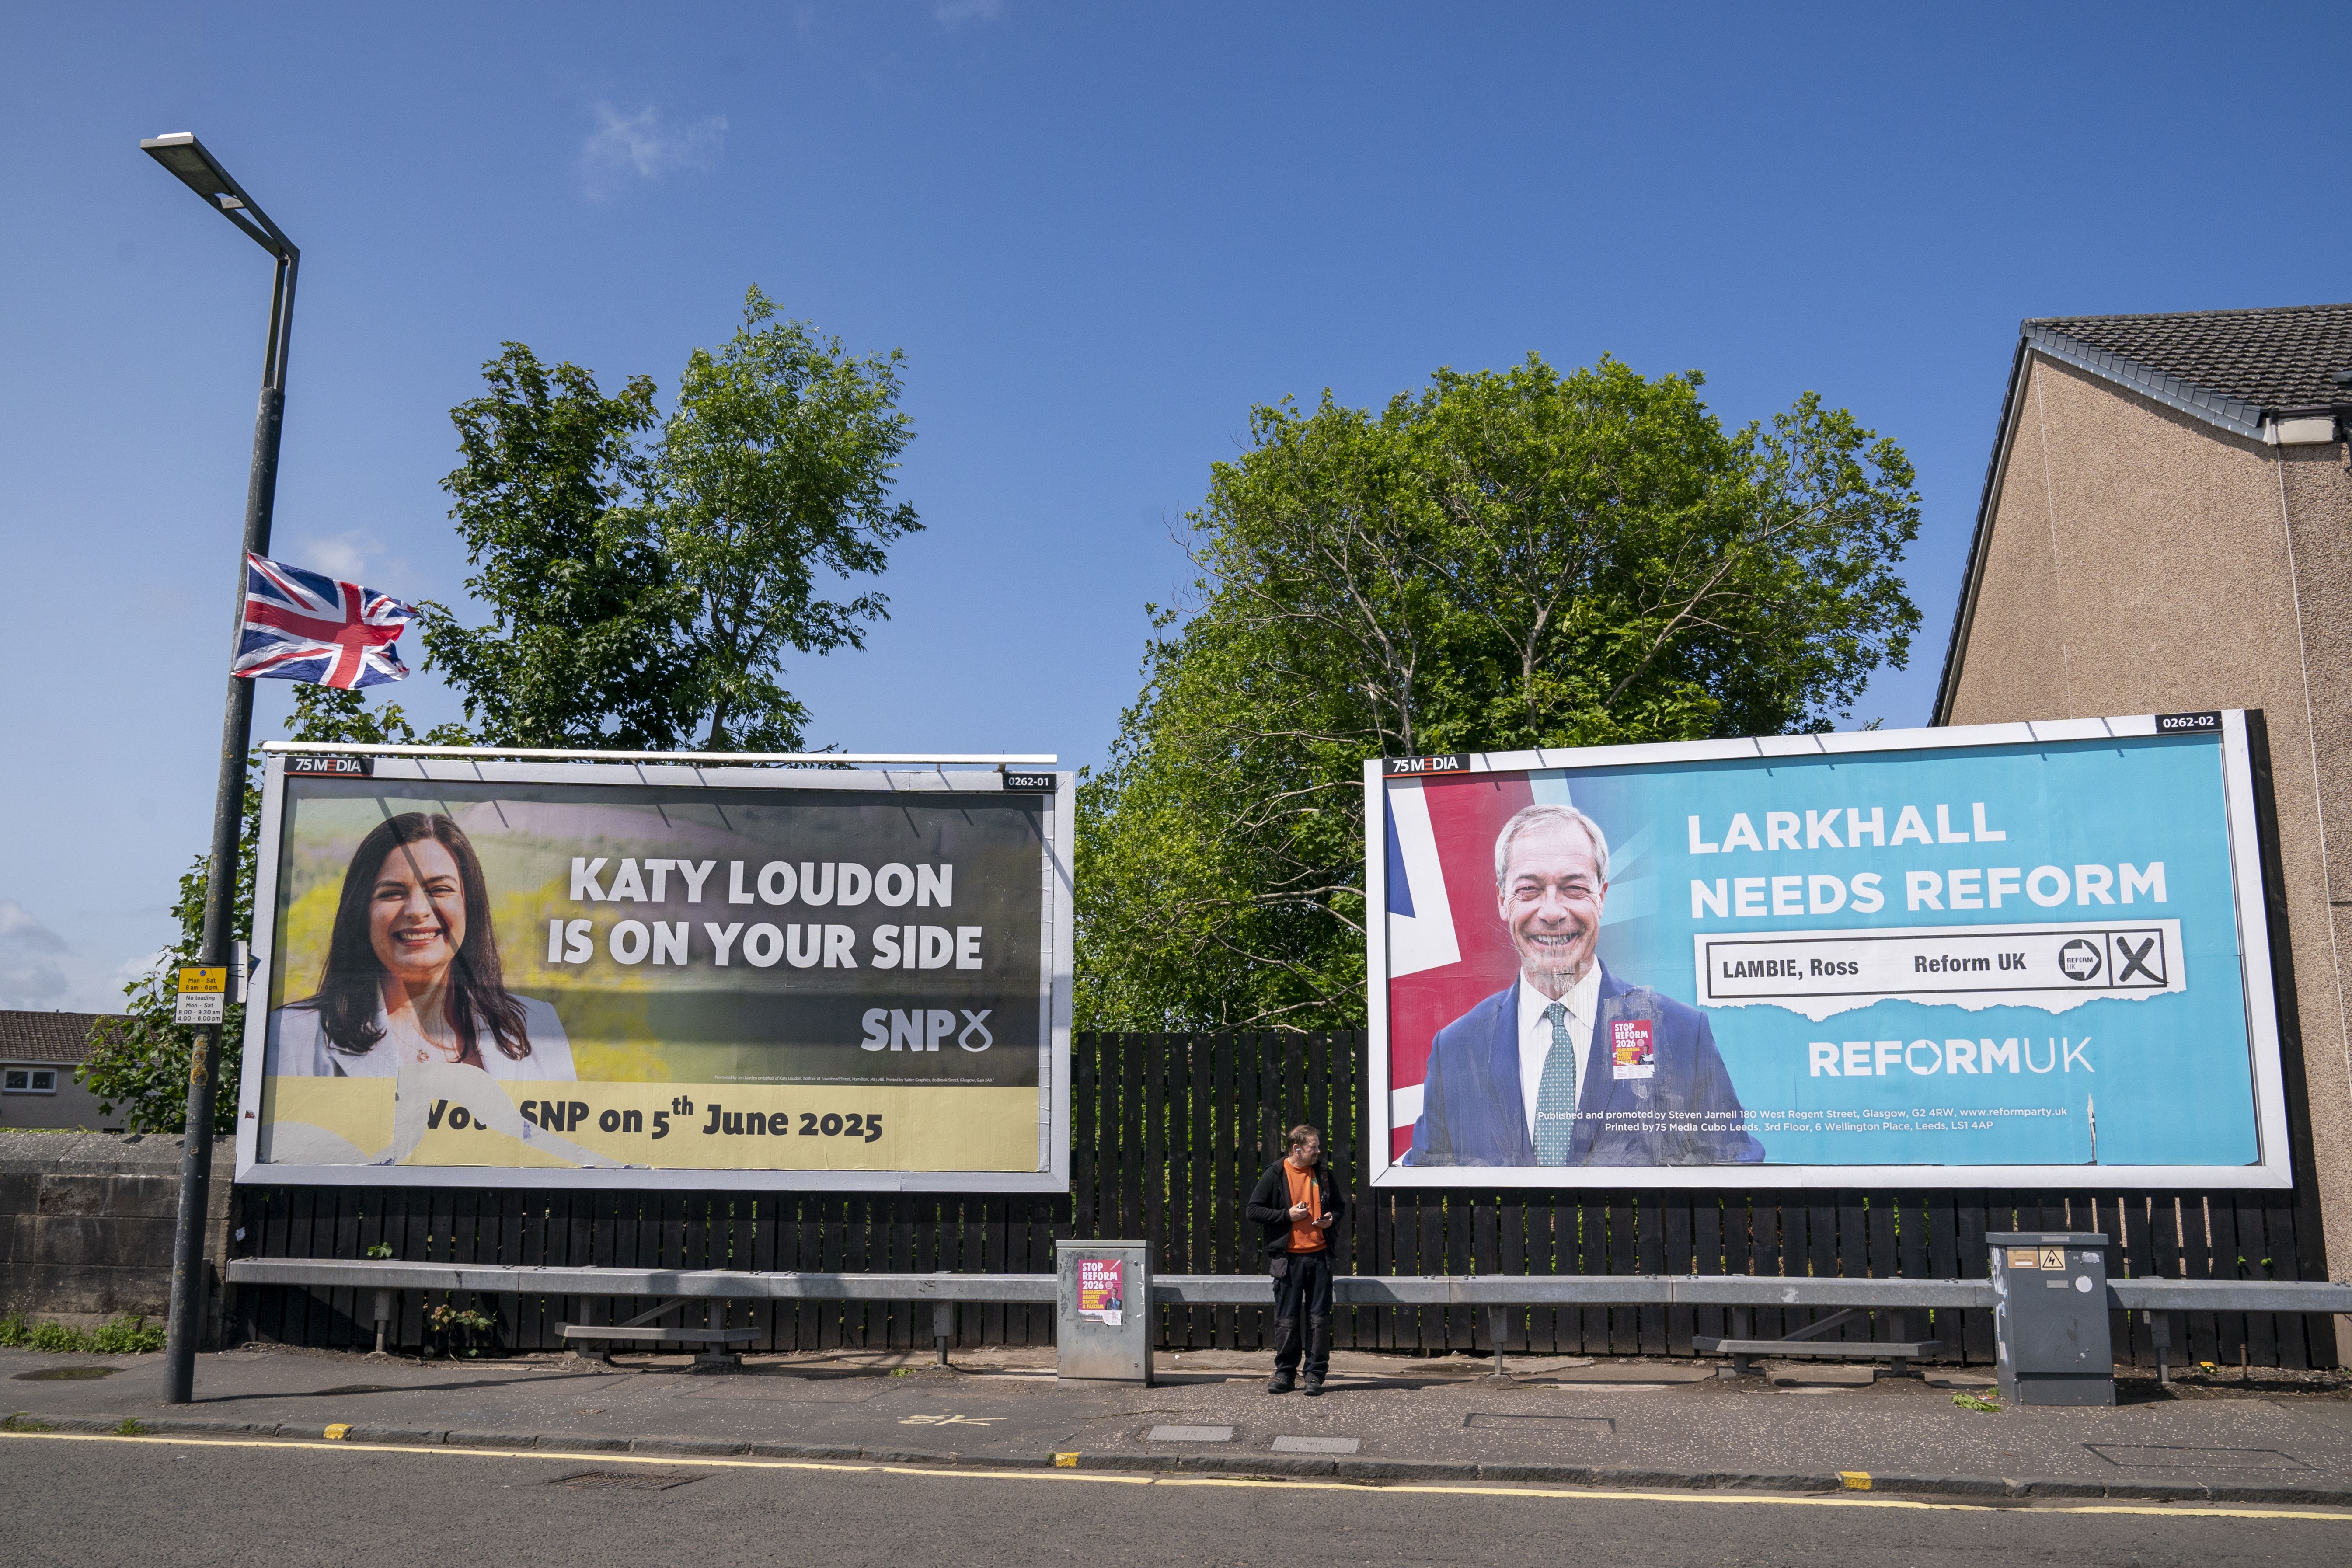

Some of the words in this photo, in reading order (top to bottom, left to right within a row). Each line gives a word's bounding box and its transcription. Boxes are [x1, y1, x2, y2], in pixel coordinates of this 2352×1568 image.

[2163, 716, 2214, 728] 0262-02
[1008, 777, 1049, 786] 0262-01
[1688, 802, 2006, 854] LARKHALL
[570, 857, 717, 903] KATY
[728, 861, 953, 908] LOUDON
[1690, 872, 1885, 919] NEEDS
[1907, 861, 2167, 912] REFORM
[548, 919, 593, 964] IS
[609, 920, 689, 966] ON
[703, 922, 858, 968] YOUR
[871, 924, 983, 969] SIDE
[1723, 959, 1803, 981] LAMBIE,
[1810, 959, 1859, 976] Ross
[1915, 955, 1990, 973] Reform
[1999, 953, 2027, 972] UK
[861, 1008, 956, 1052] SNP
[1615, 1023, 1634, 1031] STOP
[1615, 1031, 1648, 1039] REFORM
[520, 1100, 589, 1132] SNP
[599, 1109, 643, 1133] on
[652, 1095, 694, 1139] 5th
[702, 1104, 788, 1136] June
[798, 1113, 882, 1143] 2025
[1586, 1111, 1603, 1119] and
[1606, 1110, 1653, 1120] promoted
[1655, 1111, 1666, 1120] by
[1788, 1110, 1823, 1120] Regent
[1827, 1109, 1860, 1119] Street,
[1863, 1109, 1908, 1119] Glasgow,
[1912, 1109, 1926, 1117] G2
[1929, 1108, 1957, 1118] 4RW,
[1960, 1107, 2067, 1117] www.reformparty.uk
[1605, 1122, 1639, 1131] Printed
[1642, 1122, 1654, 1132] by
[1669, 1123, 1697, 1131] Media
[1701, 1123, 1727, 1131] Cubo
[1730, 1123, 1761, 1132] Leeds,
[1764, 1122, 1781, 1131] 3rd
[1784, 1122, 1812, 1132] Floor,
[1815, 1122, 1821, 1130] 6
[1825, 1122, 1879, 1132] Wellington
[1883, 1122, 1913, 1131] Place,
[1916, 1122, 1948, 1131] Leeds,
[1951, 1121, 1968, 1129] LS1
[1971, 1121, 1993, 1129] 4AP
[1083, 1262, 1103, 1271] STOP
[1083, 1272, 1118, 1281] REFORM
[1083, 1281, 1104, 1289] 2026
